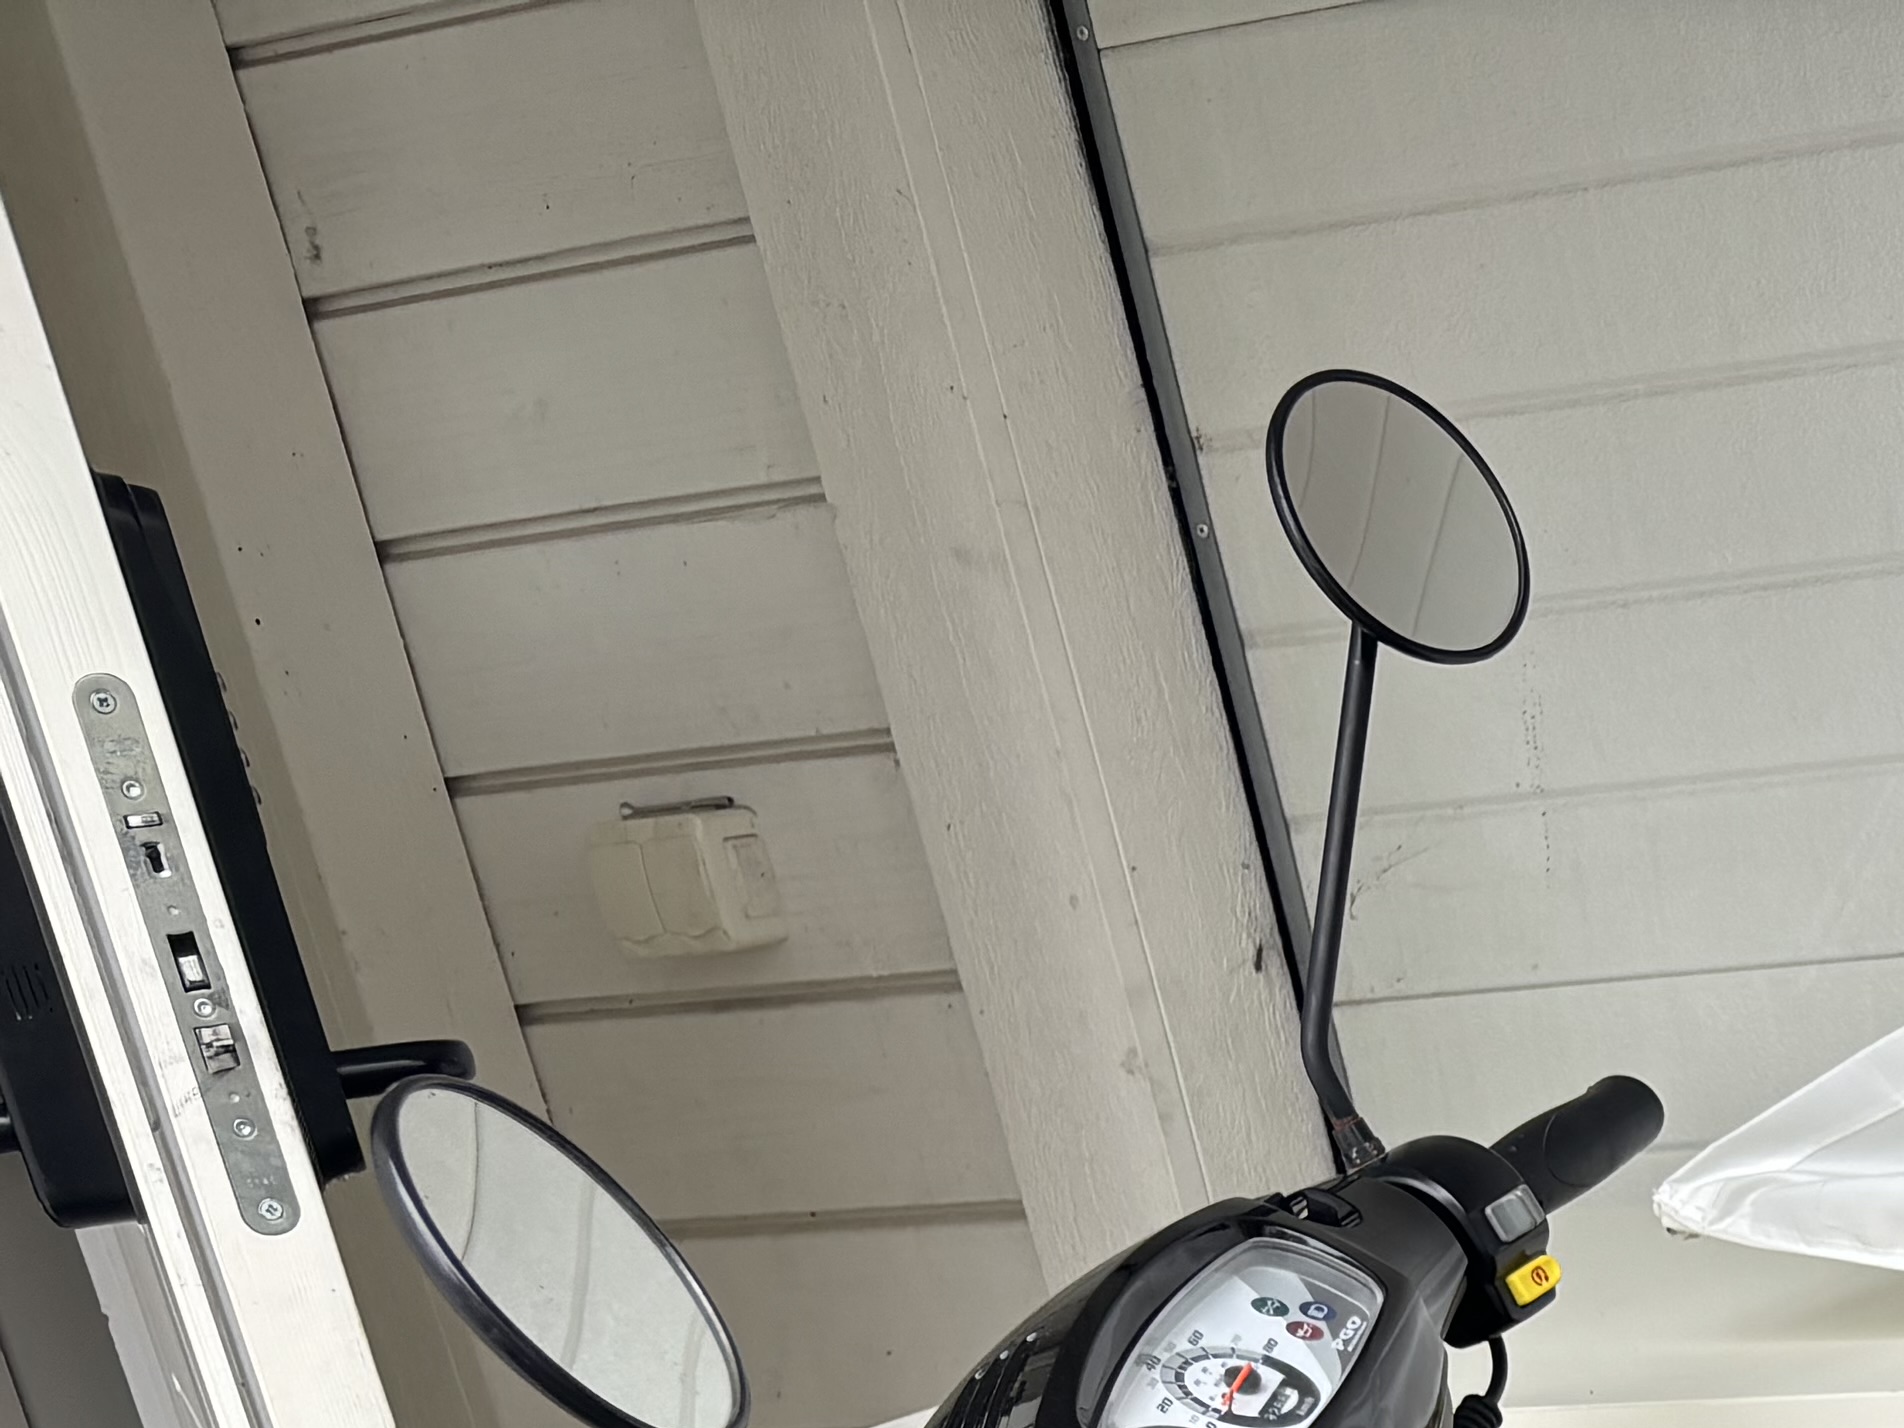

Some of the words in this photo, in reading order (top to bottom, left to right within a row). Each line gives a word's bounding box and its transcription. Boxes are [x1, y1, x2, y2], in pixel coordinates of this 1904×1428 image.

[1187, 1330, 1204, 1347] 60
[1331, 1316, 1362, 1351] PGO
[1262, 1337, 1278, 1353] 80
[1156, 1397, 1174, 1414] 20
